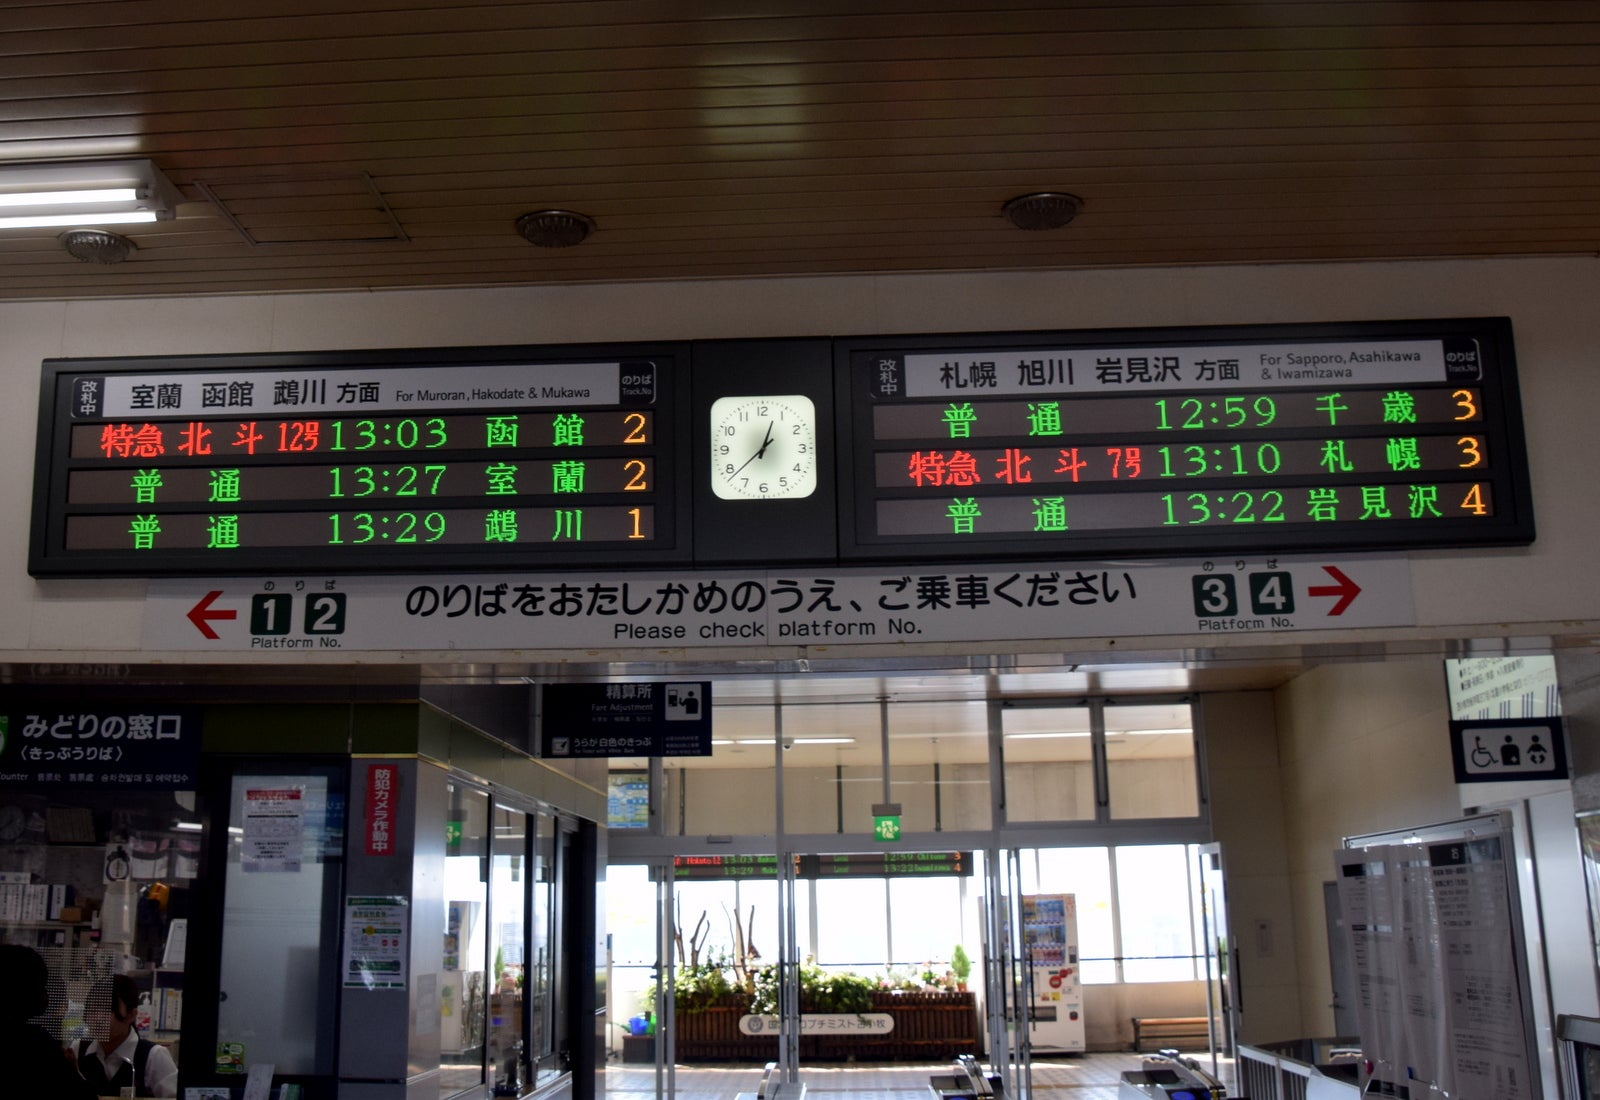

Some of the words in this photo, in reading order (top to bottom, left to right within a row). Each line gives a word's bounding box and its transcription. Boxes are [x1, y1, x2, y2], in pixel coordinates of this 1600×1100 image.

[1260, 354, 1282, 365] For
[1287, 352, 1347, 367] Sapporo,
[1349, 350, 1421, 363] Asahikawa
[1446, 350, 1476, 362] のりば
[621, 374, 652, 385] のりば
[880, 359, 897, 395] 改札中
[940, 361, 997, 389] 札幌
[1018, 358, 1074, 386] 旭川
[1096, 356, 1182, 384] 岩見沢
[1194, 359, 1239, 381] 方面
[1261, 369, 1272, 380] &
[1278, 367, 1353, 379] Iwamizawa
[80, 381, 97, 416] 改札中
[130, 383, 182, 410] 室蘭
[201, 381, 254, 407] 函館
[273, 379, 326, 406] 鵡川
[336, 381, 381, 404] 方面
[396, 390, 413, 401] For
[472, 388, 524, 400] Hakodate
[528, 388, 538, 399] &
[542, 386, 590, 399] Mukawa
[757, 406, 768, 417] 12
[941, 401, 1063, 438] 普通
[1155, 396, 1276, 430] 12:59
[1315, 391, 1416, 426] 千歳
[1452, 389, 1477, 421] 3
[100, 423, 165, 458] 特急
[277, 421, 320, 452] 12号
[331, 418, 447, 451] 13:03
[485, 414, 585, 449] 函館
[623, 413, 646, 444] 2
[725, 425, 735, 437] 10
[792, 424, 801, 435] 2
[720, 445, 729, 455] 9
[798, 443, 807, 454] 3
[725, 463, 735, 474] 8
[792, 463, 801, 472] 4
[908, 450, 981, 487] 特急
[1106, 447, 1142, 479] 7号
[1158, 443, 1281, 477] 13:10
[1320, 438, 1421, 473] 札幌
[1457, 437, 1481, 468] 3
[130, 468, 241, 504] 普通
[329, 465, 446, 498] 13:27
[485, 461, 585, 495] 室蘭
[623, 460, 647, 491] 2
[740, 478, 749, 488] 7
[759, 483, 768, 493] 6
[779, 477, 788, 487] 5
[945, 496, 1069, 534] 普通
[1161, 491, 1285, 526] 13:22
[1306, 485, 1443, 522] 岩見沢
[1460, 484, 1487, 515] 4
[128, 514, 241, 549] 普通
[328, 512, 446, 545] 13:29
[628, 508, 645, 539] 1
[1202, 578, 1229, 613] 3
[1257, 576, 1287, 611] 4
[262, 598, 276, 631] 1
[312, 597, 338, 632] 2
[614, 622, 686, 640] Please
[700, 621, 765, 639] check
[778, 619, 876, 637] platform
[888, 618, 922, 635] No.
[1199, 617, 1265, 631] Platform
[1271, 616, 1295, 629] No.
[252, 636, 313, 649] Platform
[319, 636, 342, 648] No.
[606, 684, 652, 700] 精算所
[592, 703, 607, 712] Fare
[610, 703, 653, 713] Adjustment
[22, 714, 182, 740] みどりの窓口
[372, 768, 391, 852] 防犯カメラ作動中
[953, 862, 962, 872] 4
